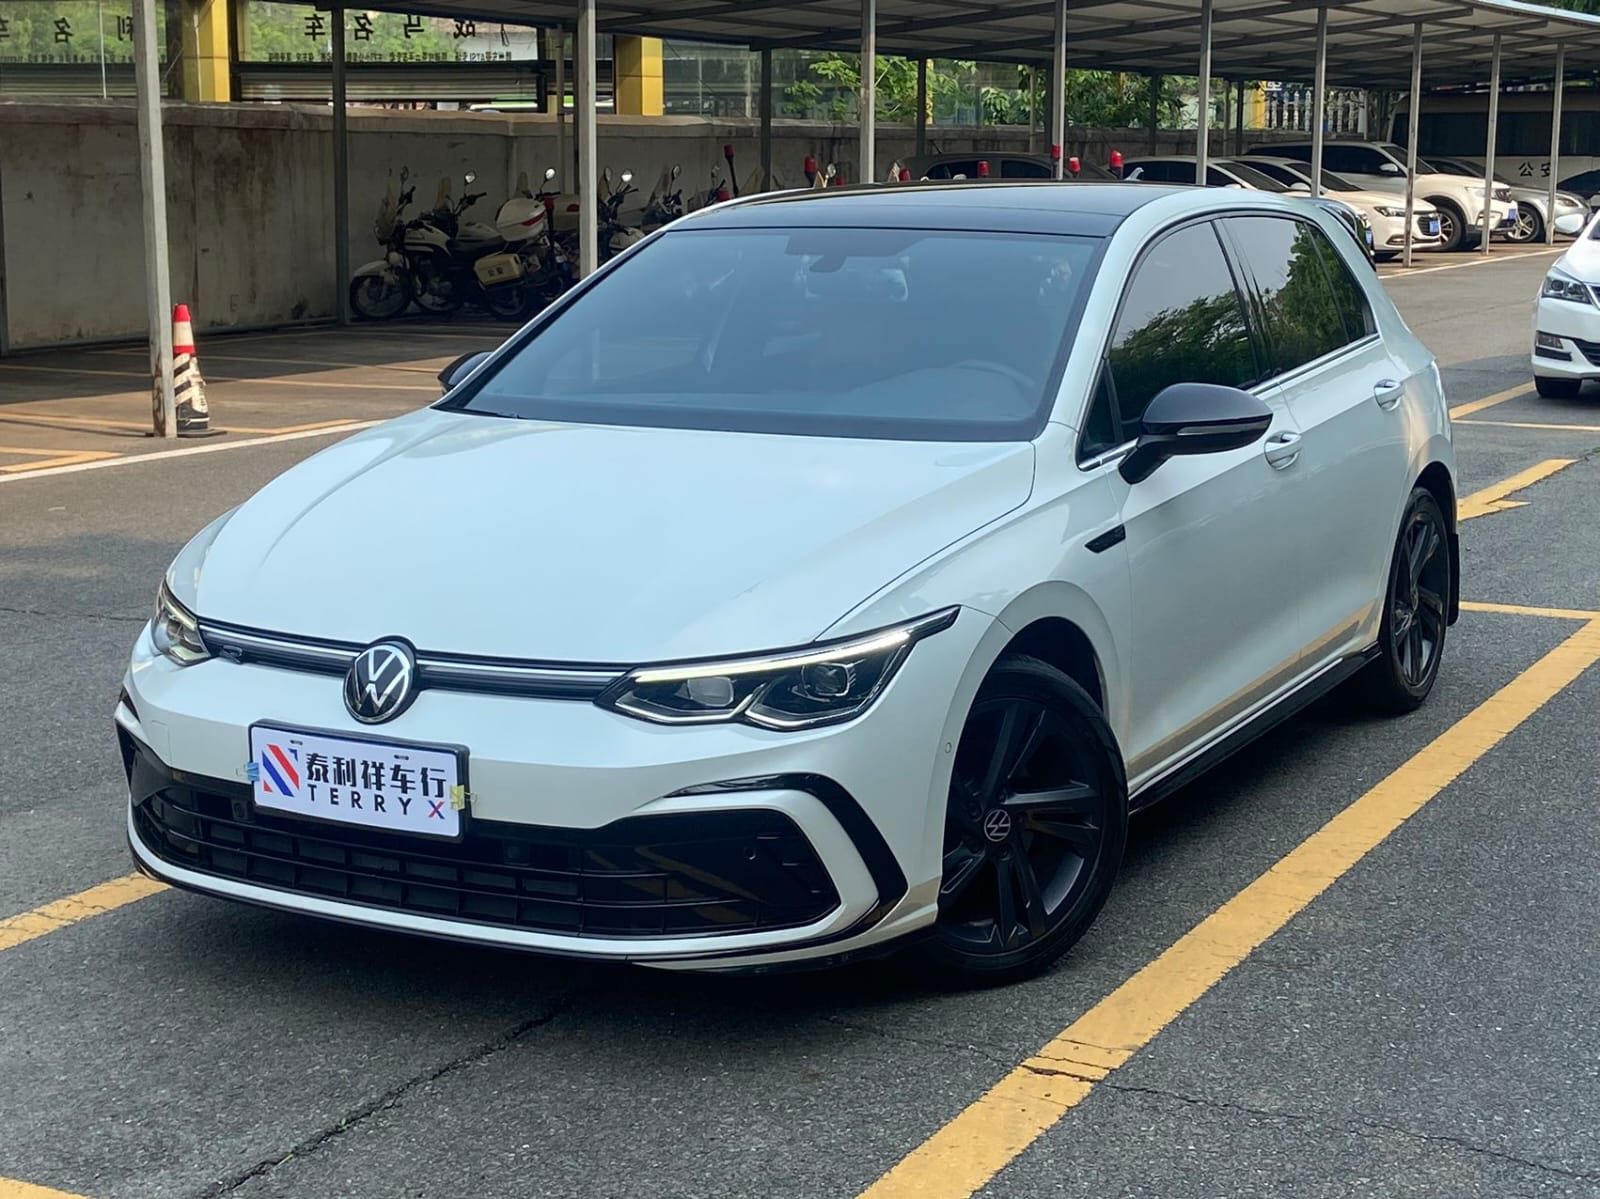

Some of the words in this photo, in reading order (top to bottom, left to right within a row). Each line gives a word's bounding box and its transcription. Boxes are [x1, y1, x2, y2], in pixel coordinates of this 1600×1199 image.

[306, 752, 447, 798] 泰利祥车行
[307, 784, 446, 820] TERRYX
